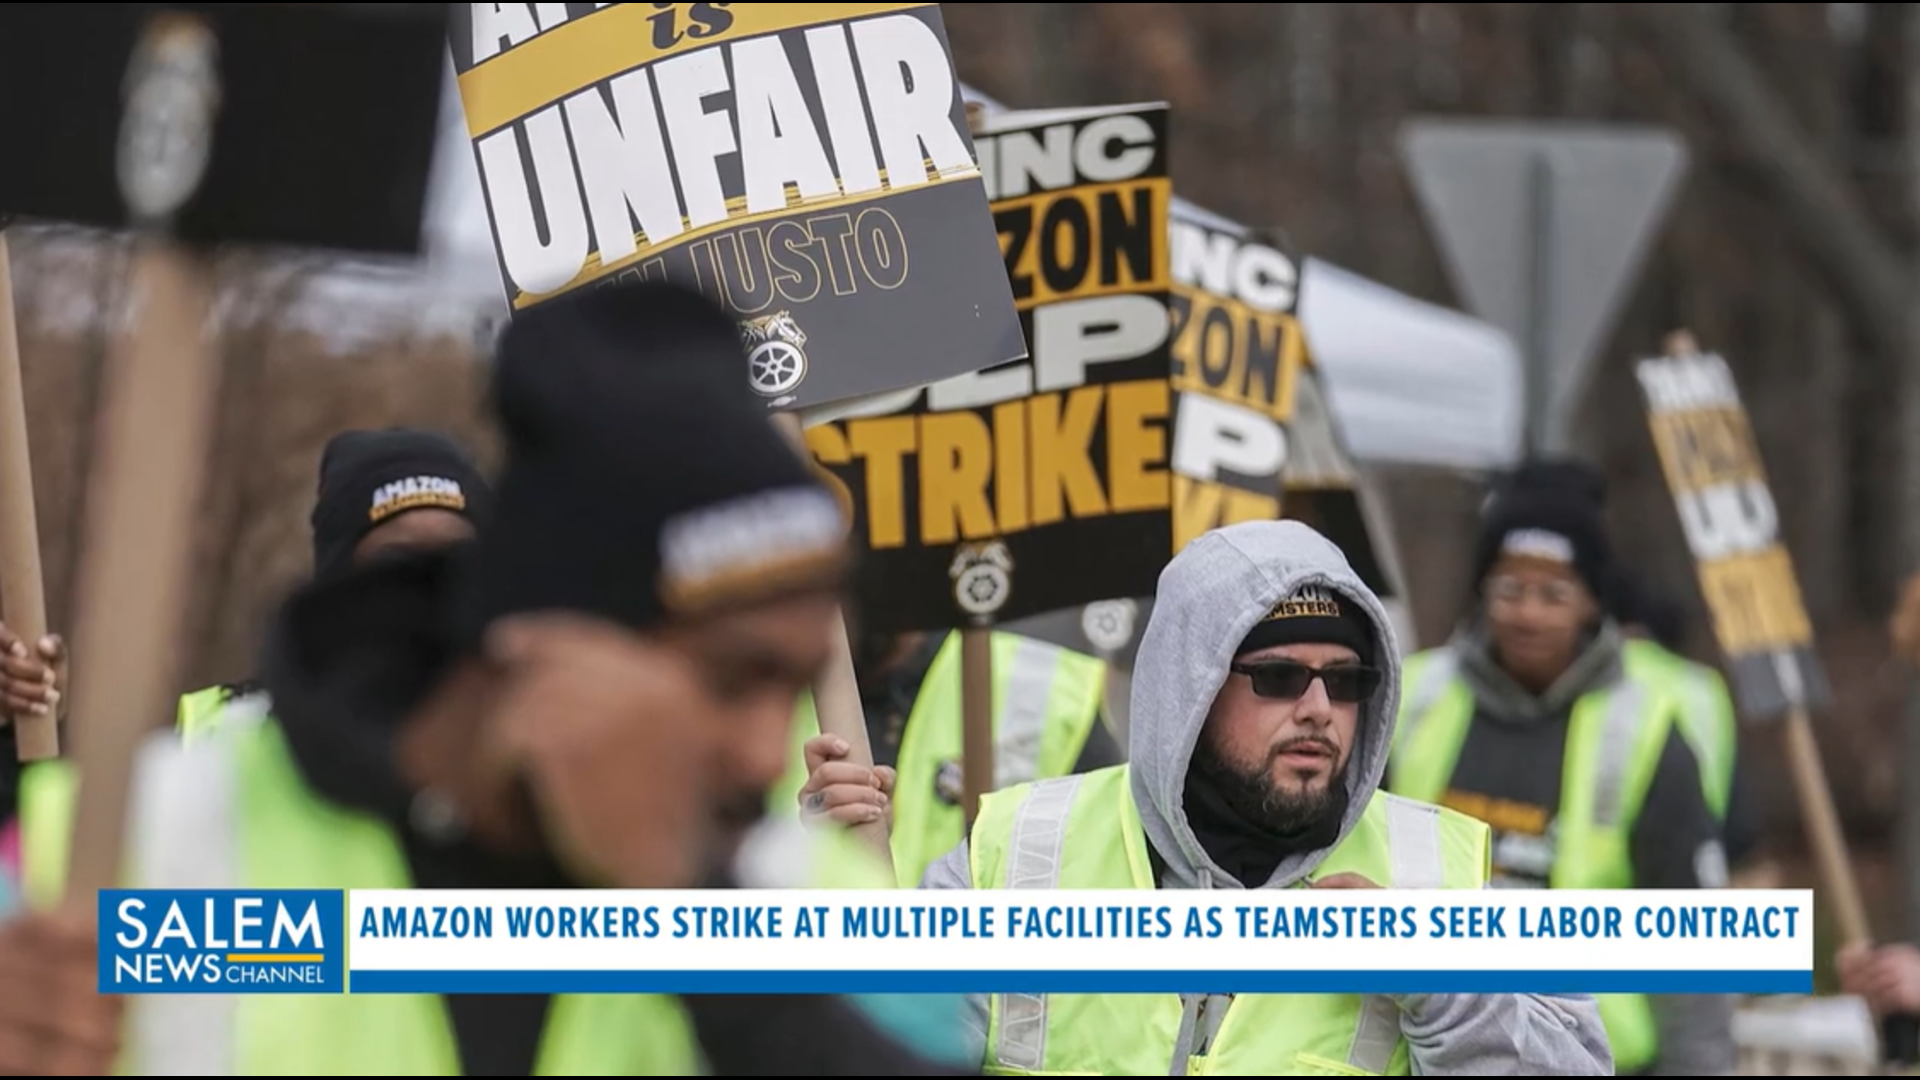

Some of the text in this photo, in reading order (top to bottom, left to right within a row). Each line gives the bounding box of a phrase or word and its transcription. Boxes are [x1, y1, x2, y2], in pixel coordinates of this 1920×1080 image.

[645, 3, 734, 50] is
[478, 14, 982, 294] UNFAIR
[597, 207, 909, 314] JUSTO
[992, 186, 1154, 298] ZON
[373, 475, 461, 509] AMAZON
